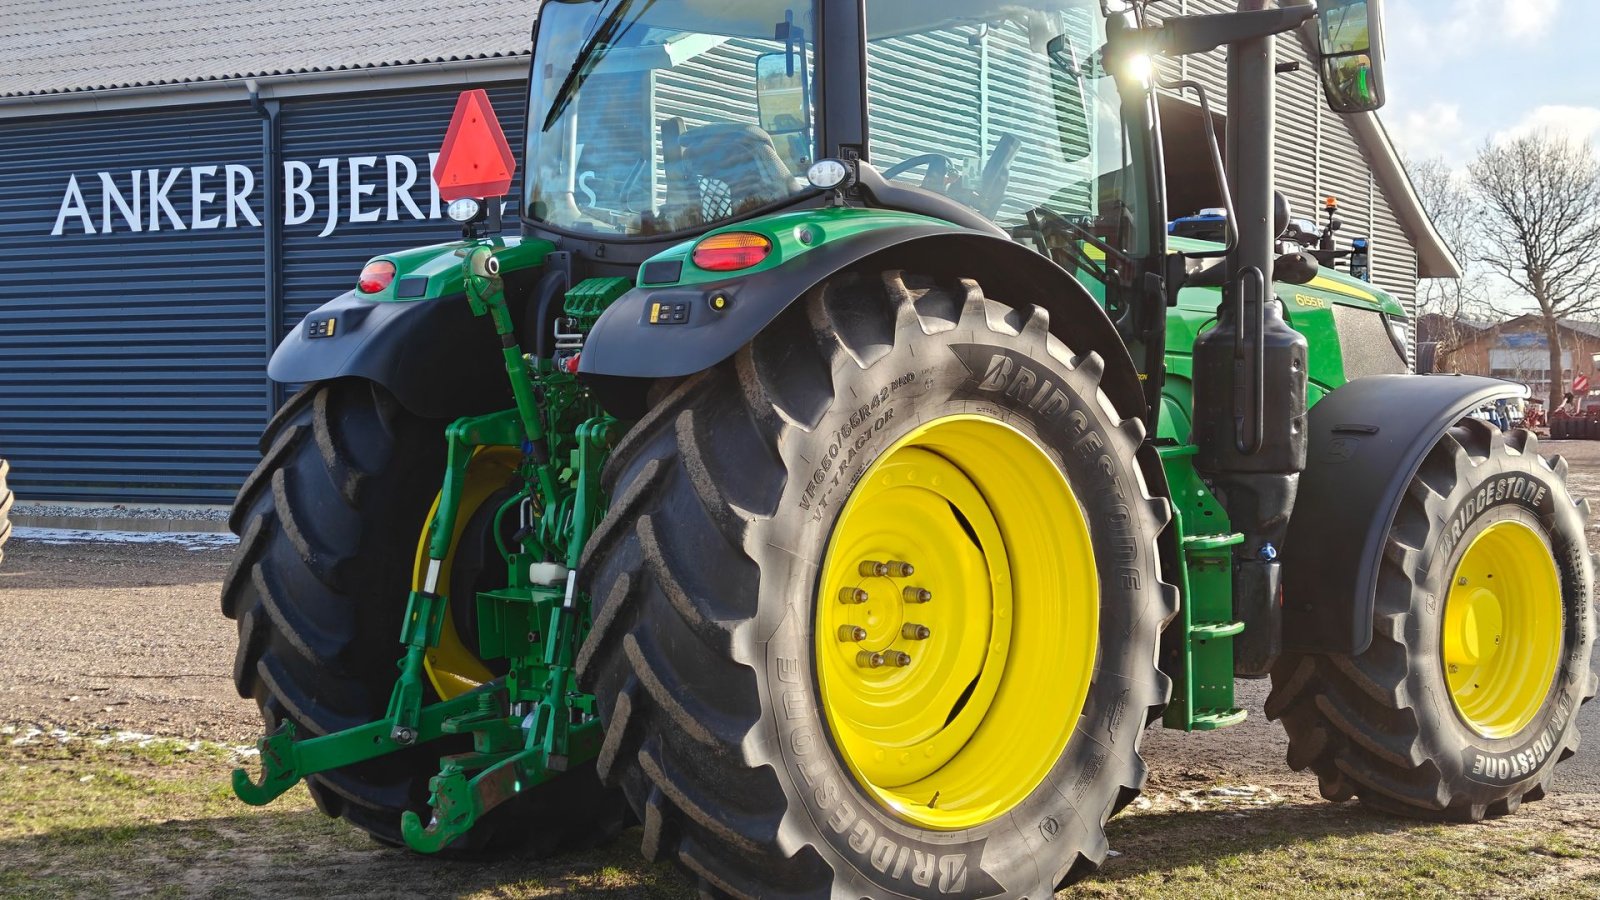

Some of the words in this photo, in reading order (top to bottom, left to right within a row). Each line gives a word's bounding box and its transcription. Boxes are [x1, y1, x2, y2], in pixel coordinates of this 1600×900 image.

[50, 164, 263, 236] ANKER
[283, 152, 507, 238] BJER
[1295, 293, 1325, 308] 6155R
[799, 386, 890, 511] VF650/65R42
[812, 407, 895, 523] VT-TRACTOR
[978, 354, 1142, 592] BRIDGESTONE
[1439, 475, 1546, 558] BRIDGESTONE
[776, 656, 967, 894] BRIDGESTONE
[1473, 688, 1572, 779] BRIDGESTONE
